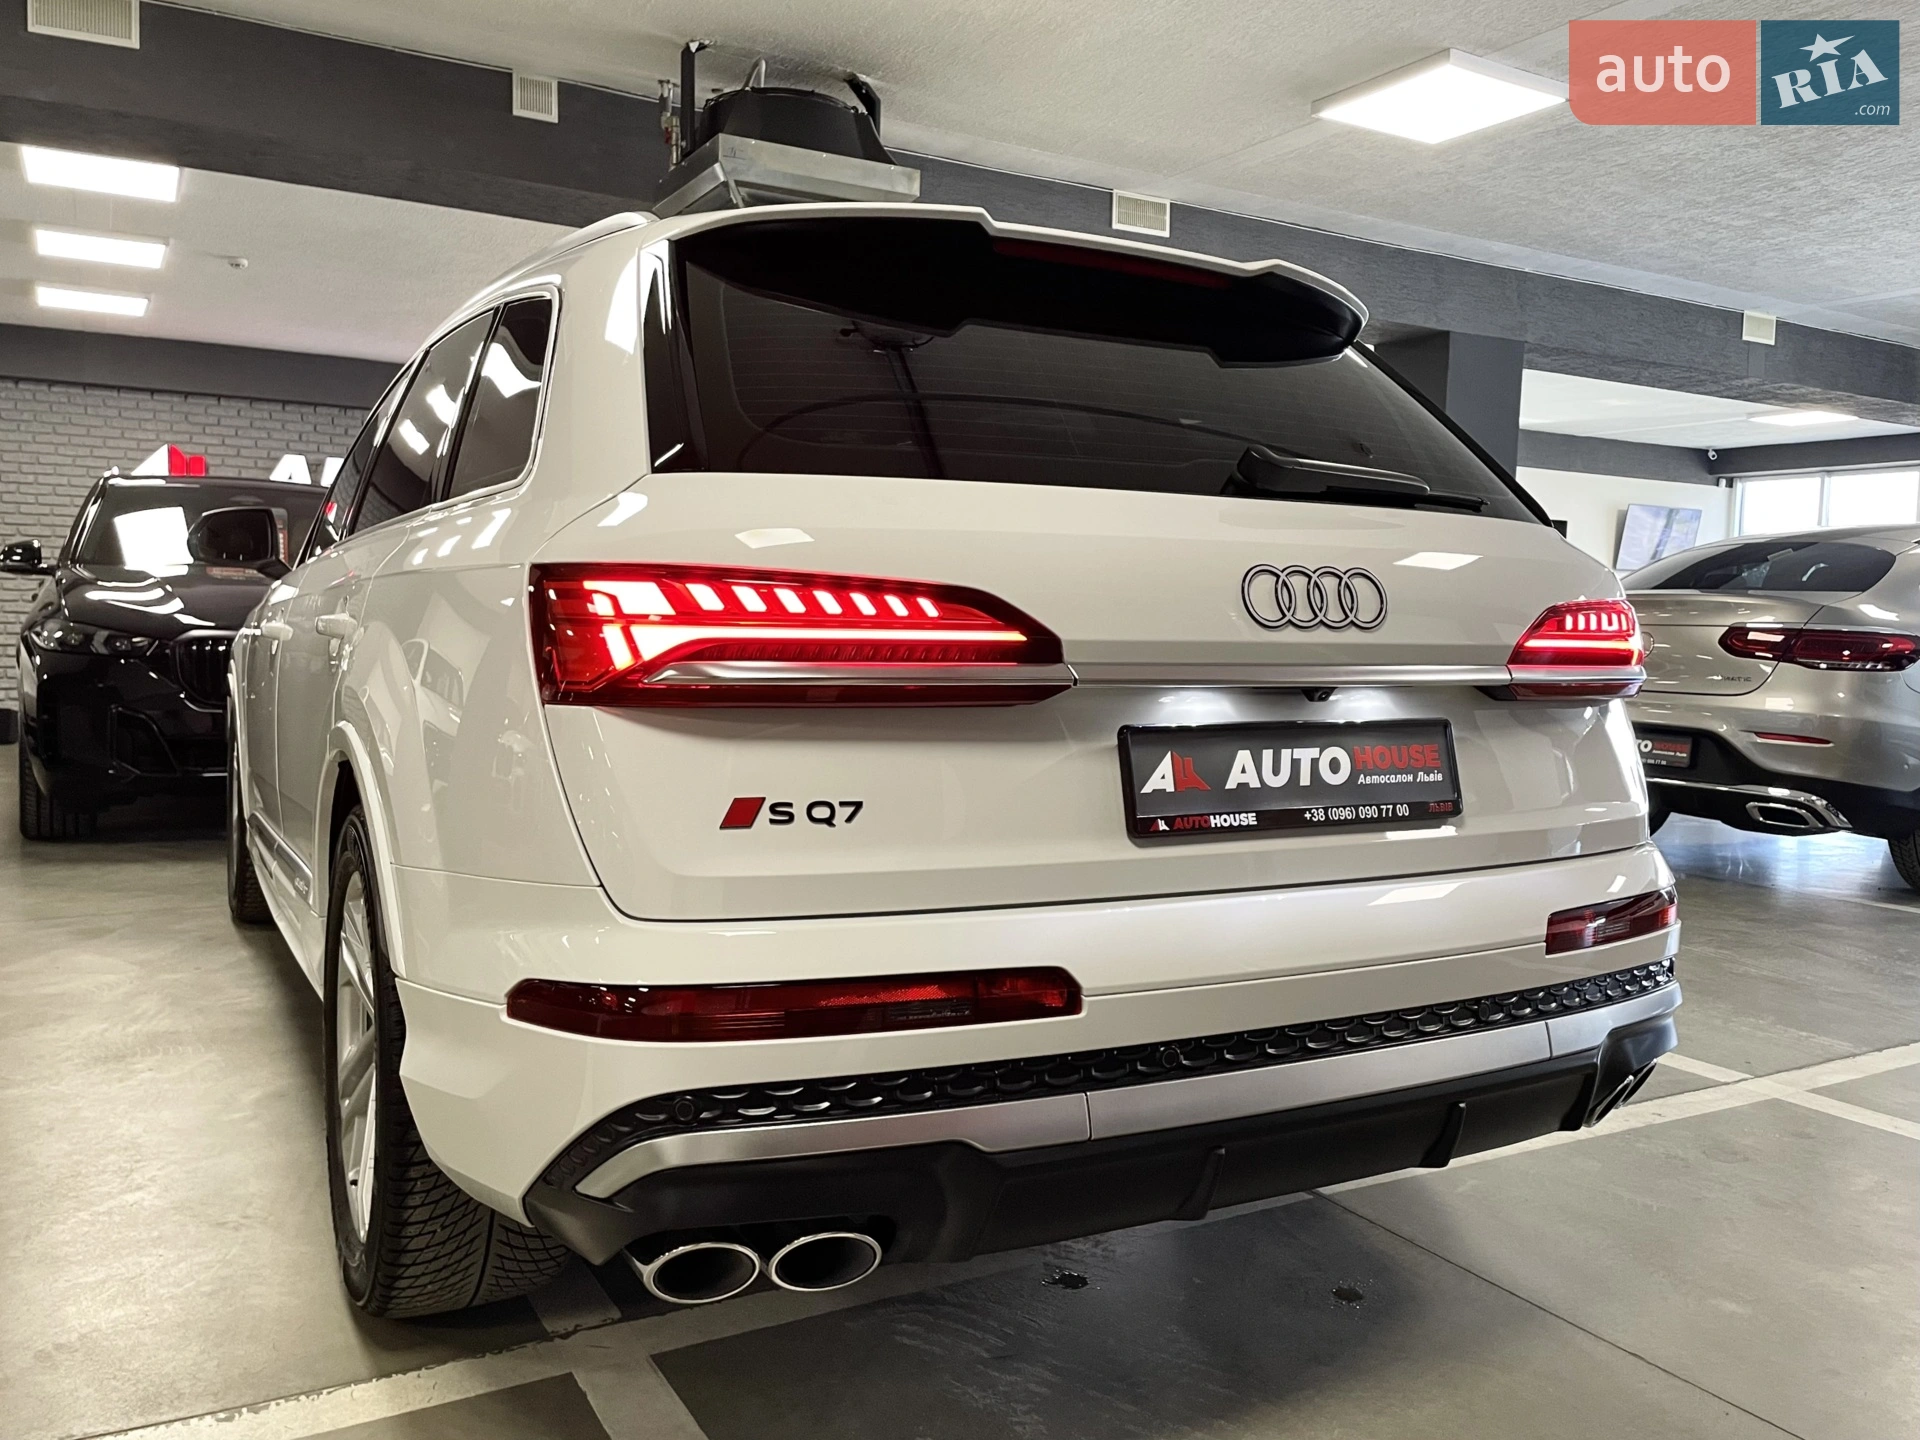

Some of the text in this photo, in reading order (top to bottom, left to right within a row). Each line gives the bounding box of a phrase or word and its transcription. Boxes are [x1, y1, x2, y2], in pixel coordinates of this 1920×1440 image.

[1225, 744, 1442, 790] AUTO HOUSE
[1357, 770, 1443, 785] Автосалон Львів
[1173, 813, 1258, 830] AUTOHOUSE
[1304, 804, 1410, 822] +38 (096) 090 77 00
